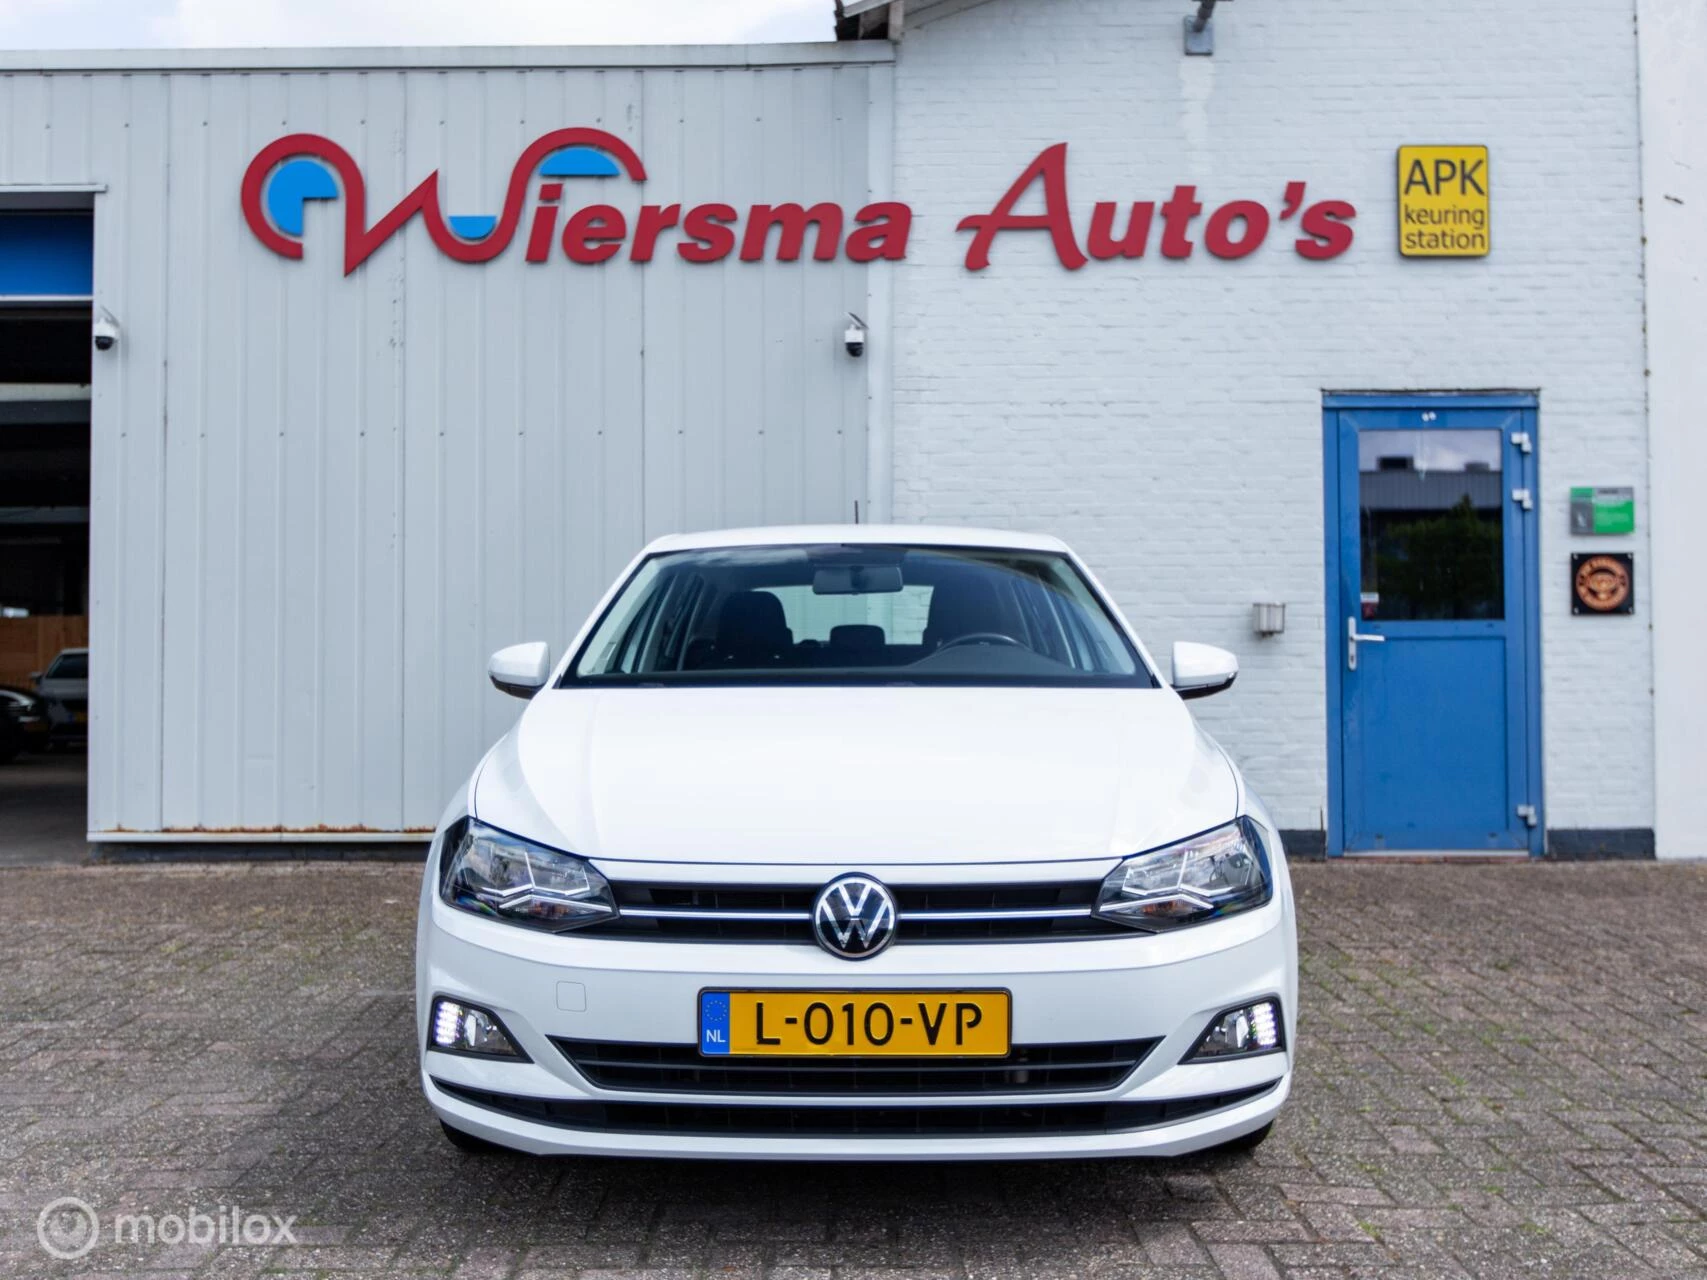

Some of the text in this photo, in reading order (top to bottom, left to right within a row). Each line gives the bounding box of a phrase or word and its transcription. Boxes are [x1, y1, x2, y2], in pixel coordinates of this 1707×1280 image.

[1404, 158, 1485, 196] APK
[241, 127, 1357, 277] Wiersma Auto's
[1404, 203, 1485, 230] keuring
[1405, 229, 1485, 249] station
[706, 1030, 726, 1043] NL
[756, 1002, 982, 1046] L-010-VP
